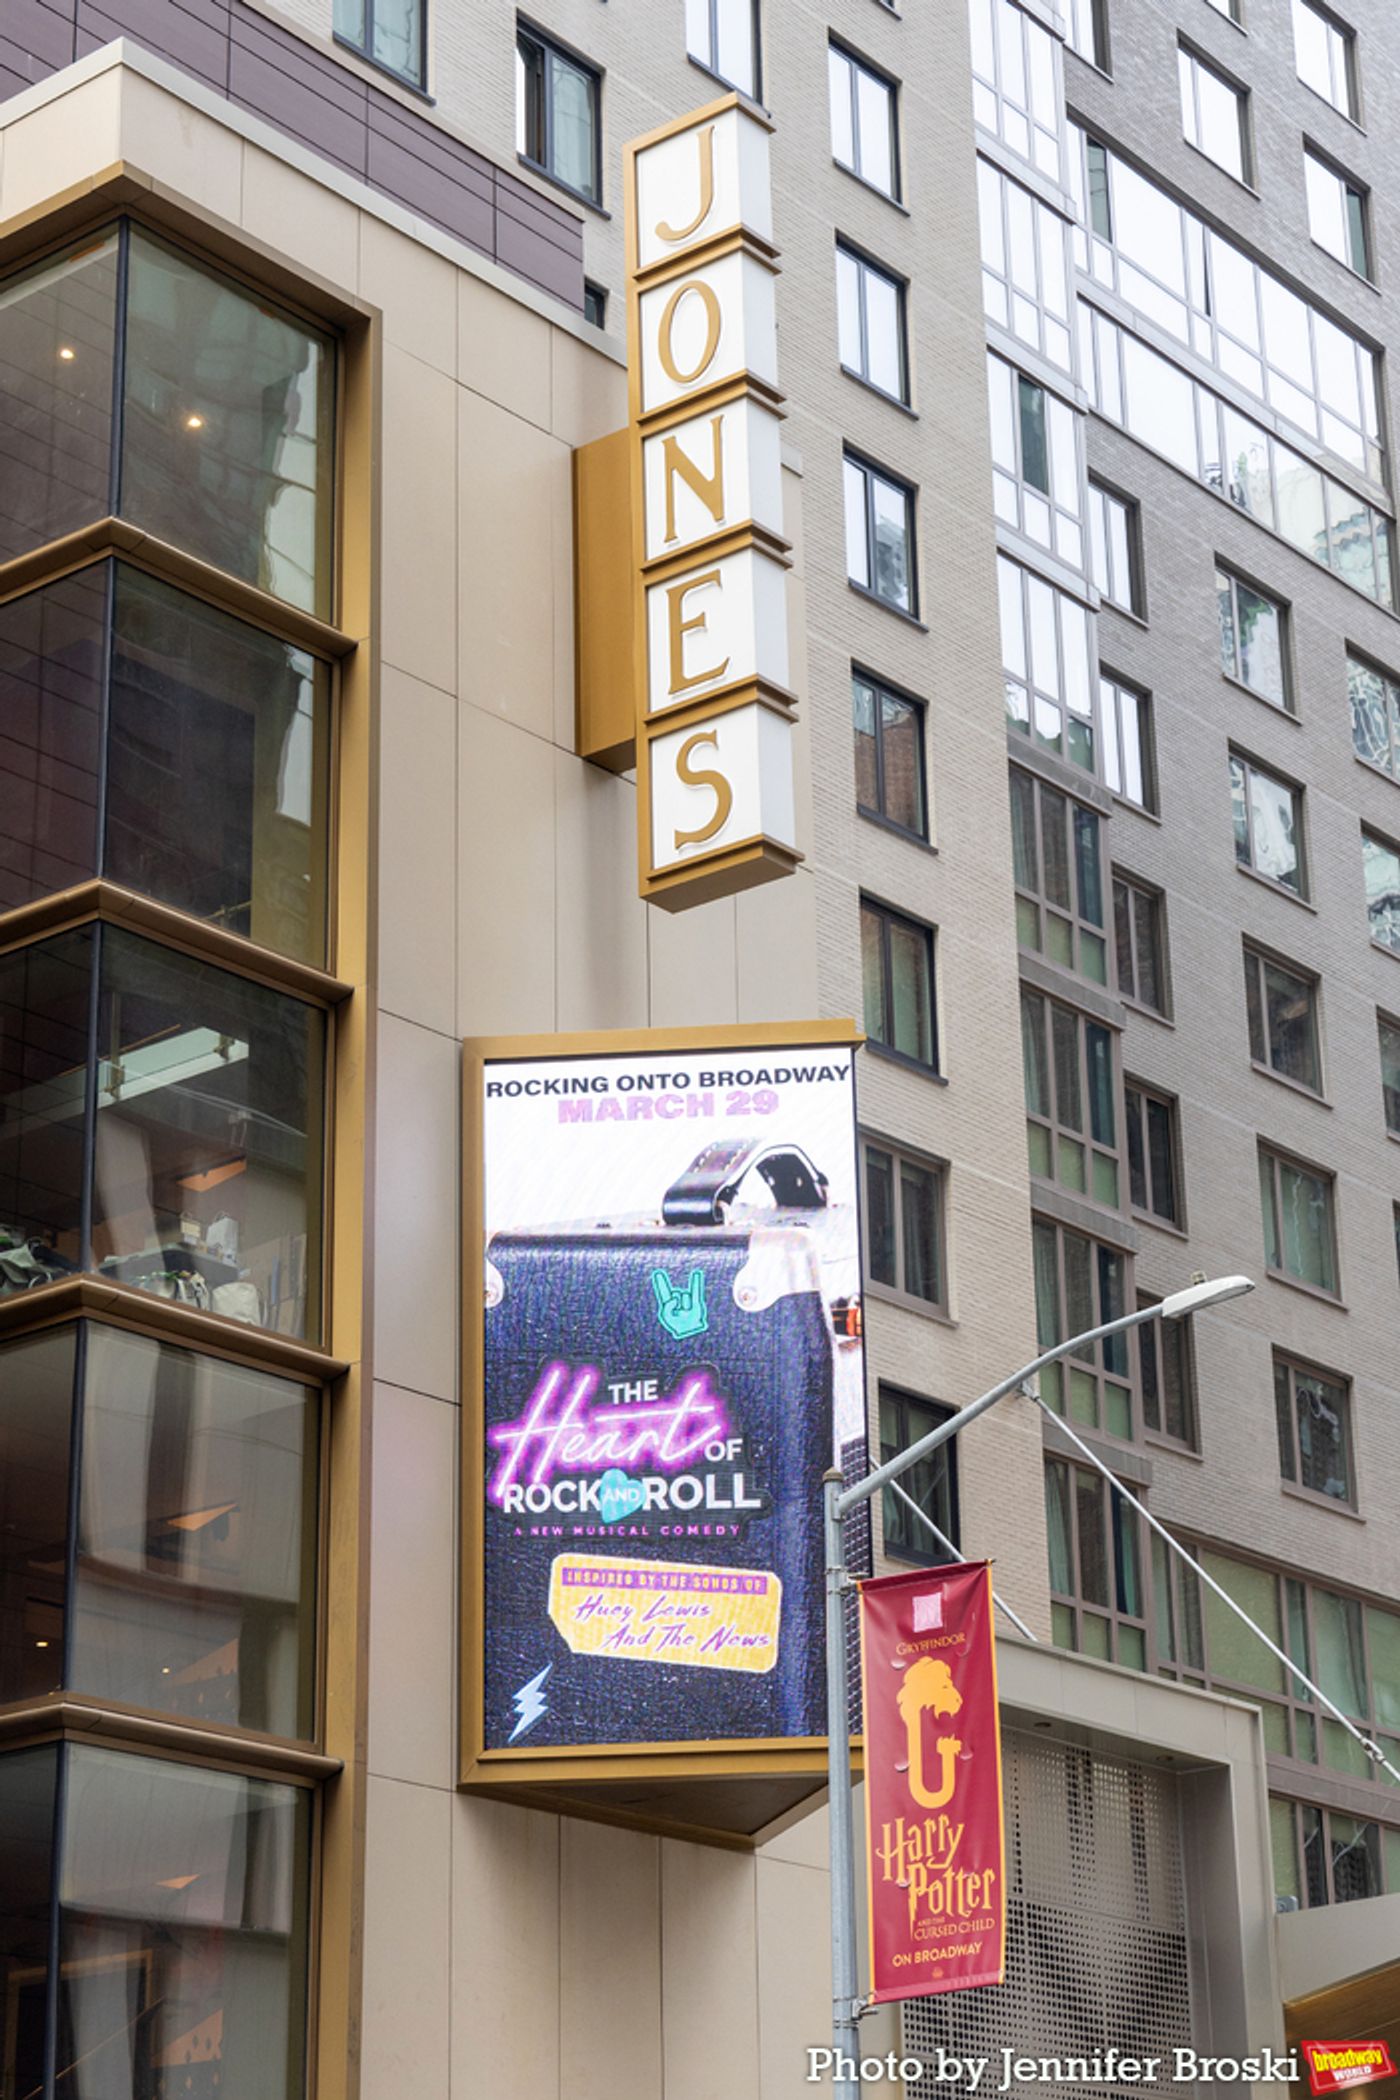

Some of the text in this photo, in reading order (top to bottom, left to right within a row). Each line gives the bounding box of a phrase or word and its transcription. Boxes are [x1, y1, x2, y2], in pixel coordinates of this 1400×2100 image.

[655, 125, 733, 851] JONES
[486, 1065, 850, 1098] ROCKING ONTO BROADWAY
[557, 1089, 780, 1124] MARCH 29
[608, 1379, 658, 1405] THE
[492, 1367, 724, 1499] Heart
[704, 1437, 744, 1463] OF
[503, 1472, 762, 1513] ROCK AND ROLL
[513, 1524, 742, 1537] A NEW MUSICAL COMEDY
[567, 1570, 633, 1586] INSPIRED
[639, 1573, 657, 1586] BY
[661, 1574, 687, 1588] THE
[745, 1577, 762, 1591] OF
[572, 1593, 712, 1623] Huey Lewis
[601, 1622, 771, 1653] And The News
[875, 1814, 965, 1885] Harry
[907, 1862, 996, 1940] Potter
[914, 1917, 996, 1941] CURSED CHILD
[892, 1941, 984, 1968] ON BROADWAY
